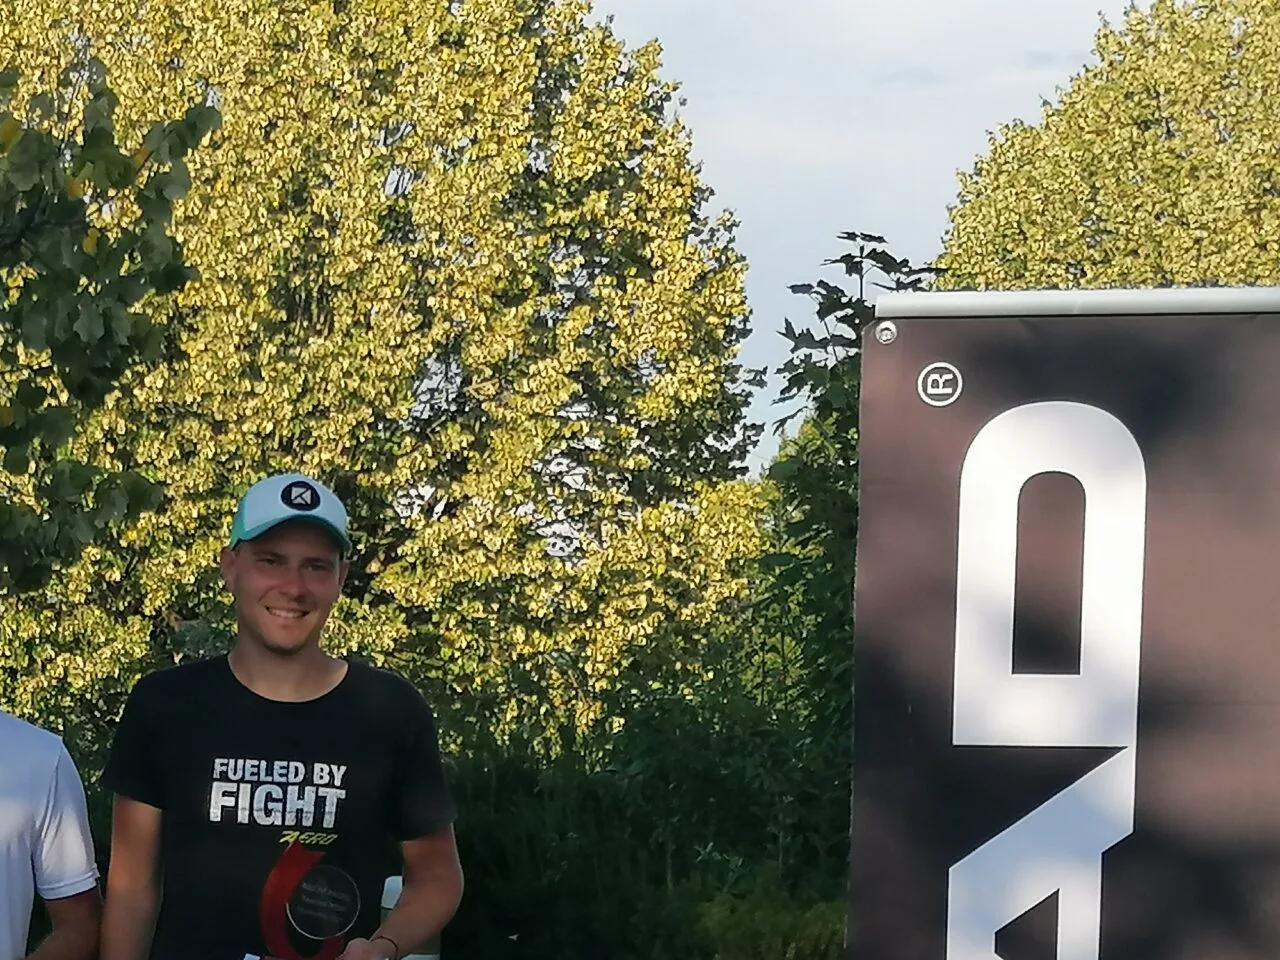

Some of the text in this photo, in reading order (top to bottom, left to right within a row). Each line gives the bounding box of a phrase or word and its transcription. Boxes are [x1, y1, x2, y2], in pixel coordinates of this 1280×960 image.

[213, 758, 347, 786] FUELED BY
[209, 781, 346, 829] FIGHT
